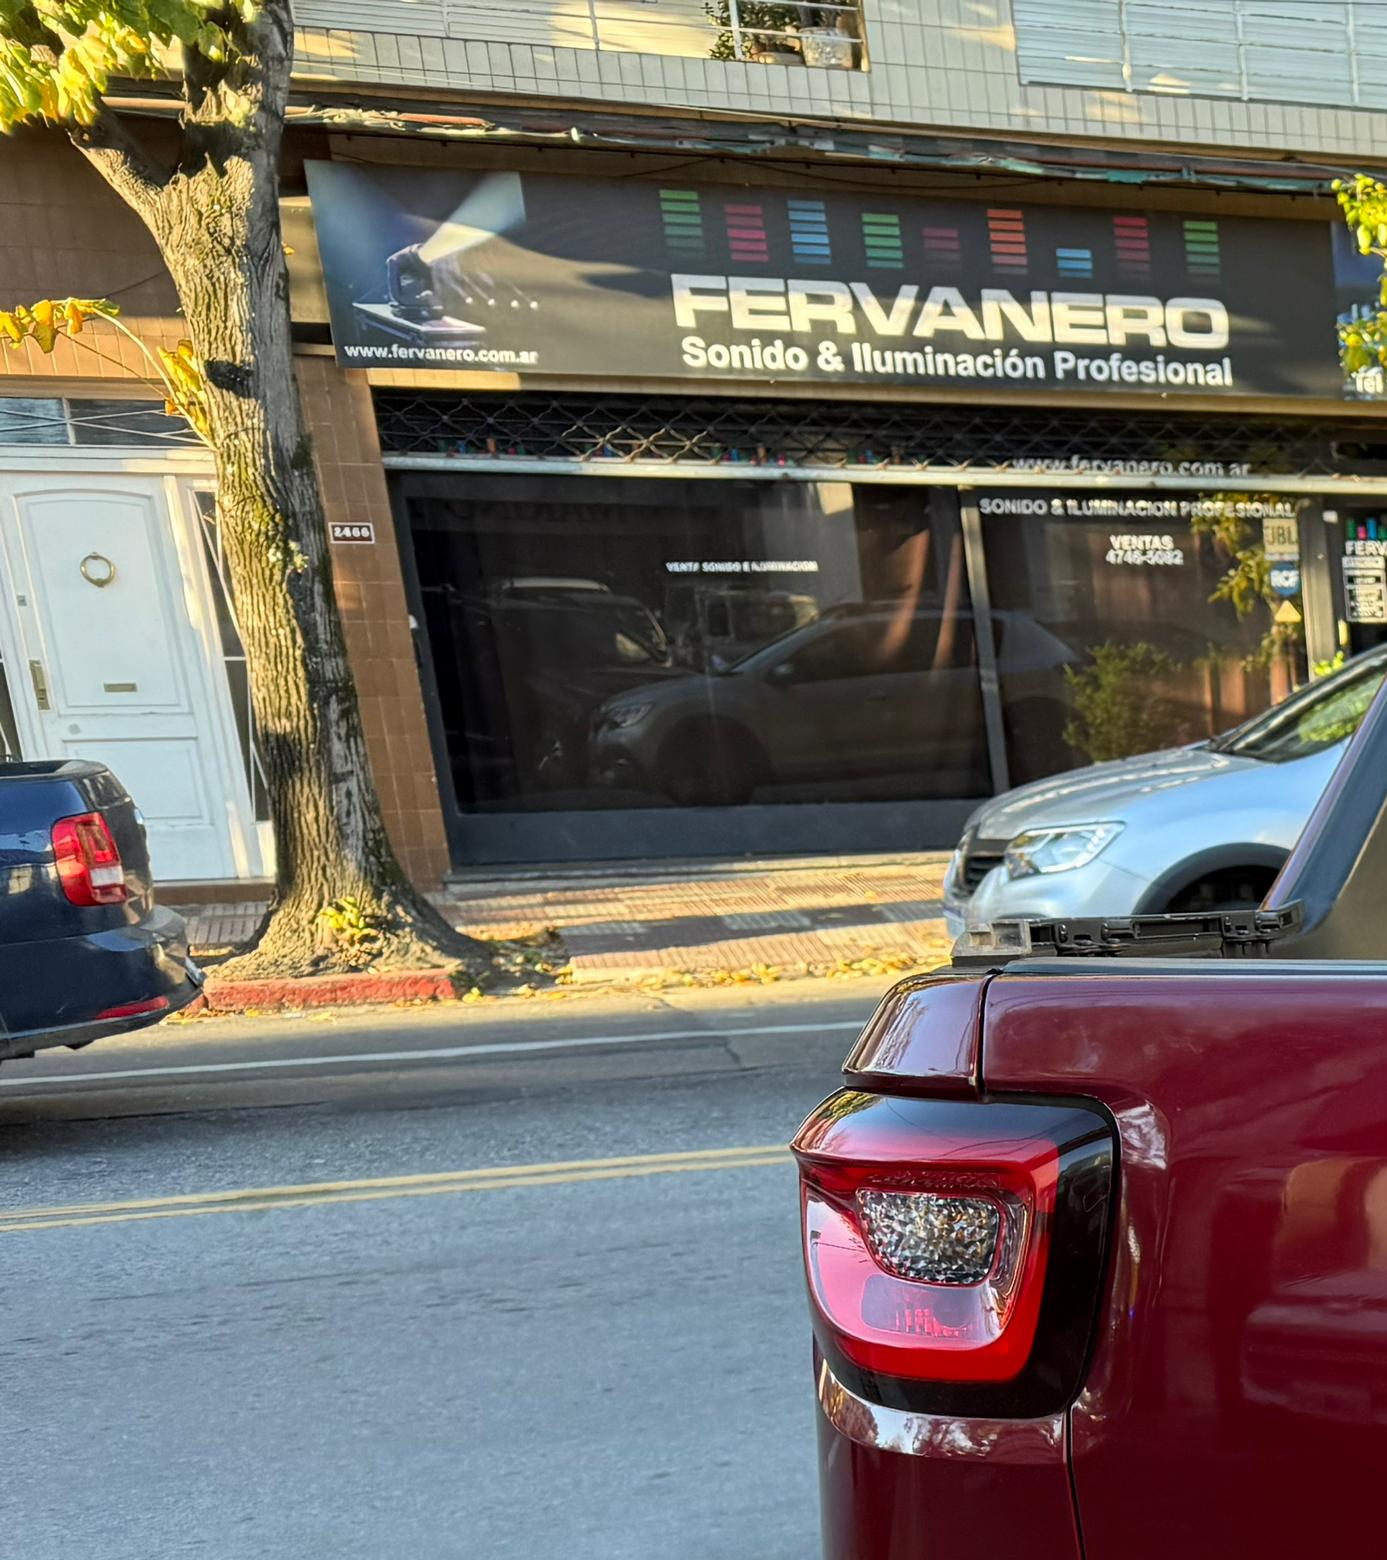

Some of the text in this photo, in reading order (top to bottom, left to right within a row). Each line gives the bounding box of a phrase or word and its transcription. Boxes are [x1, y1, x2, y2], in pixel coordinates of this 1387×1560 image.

[671, 273, 1230, 350] FERVANERO
[344, 343, 539, 366] www.fervanero.com.ar
[681, 335, 1234, 387] Sonido & Iluminación Profesional
[1011, 454, 1252, 477] www.fervanero.comar
[979, 497, 1048, 516] SONIDO
[1051, 498, 1065, 516] &
[1180, 501, 1297, 519] PROFESIONAL
[1109, 535, 1175, 551] VENTAS
